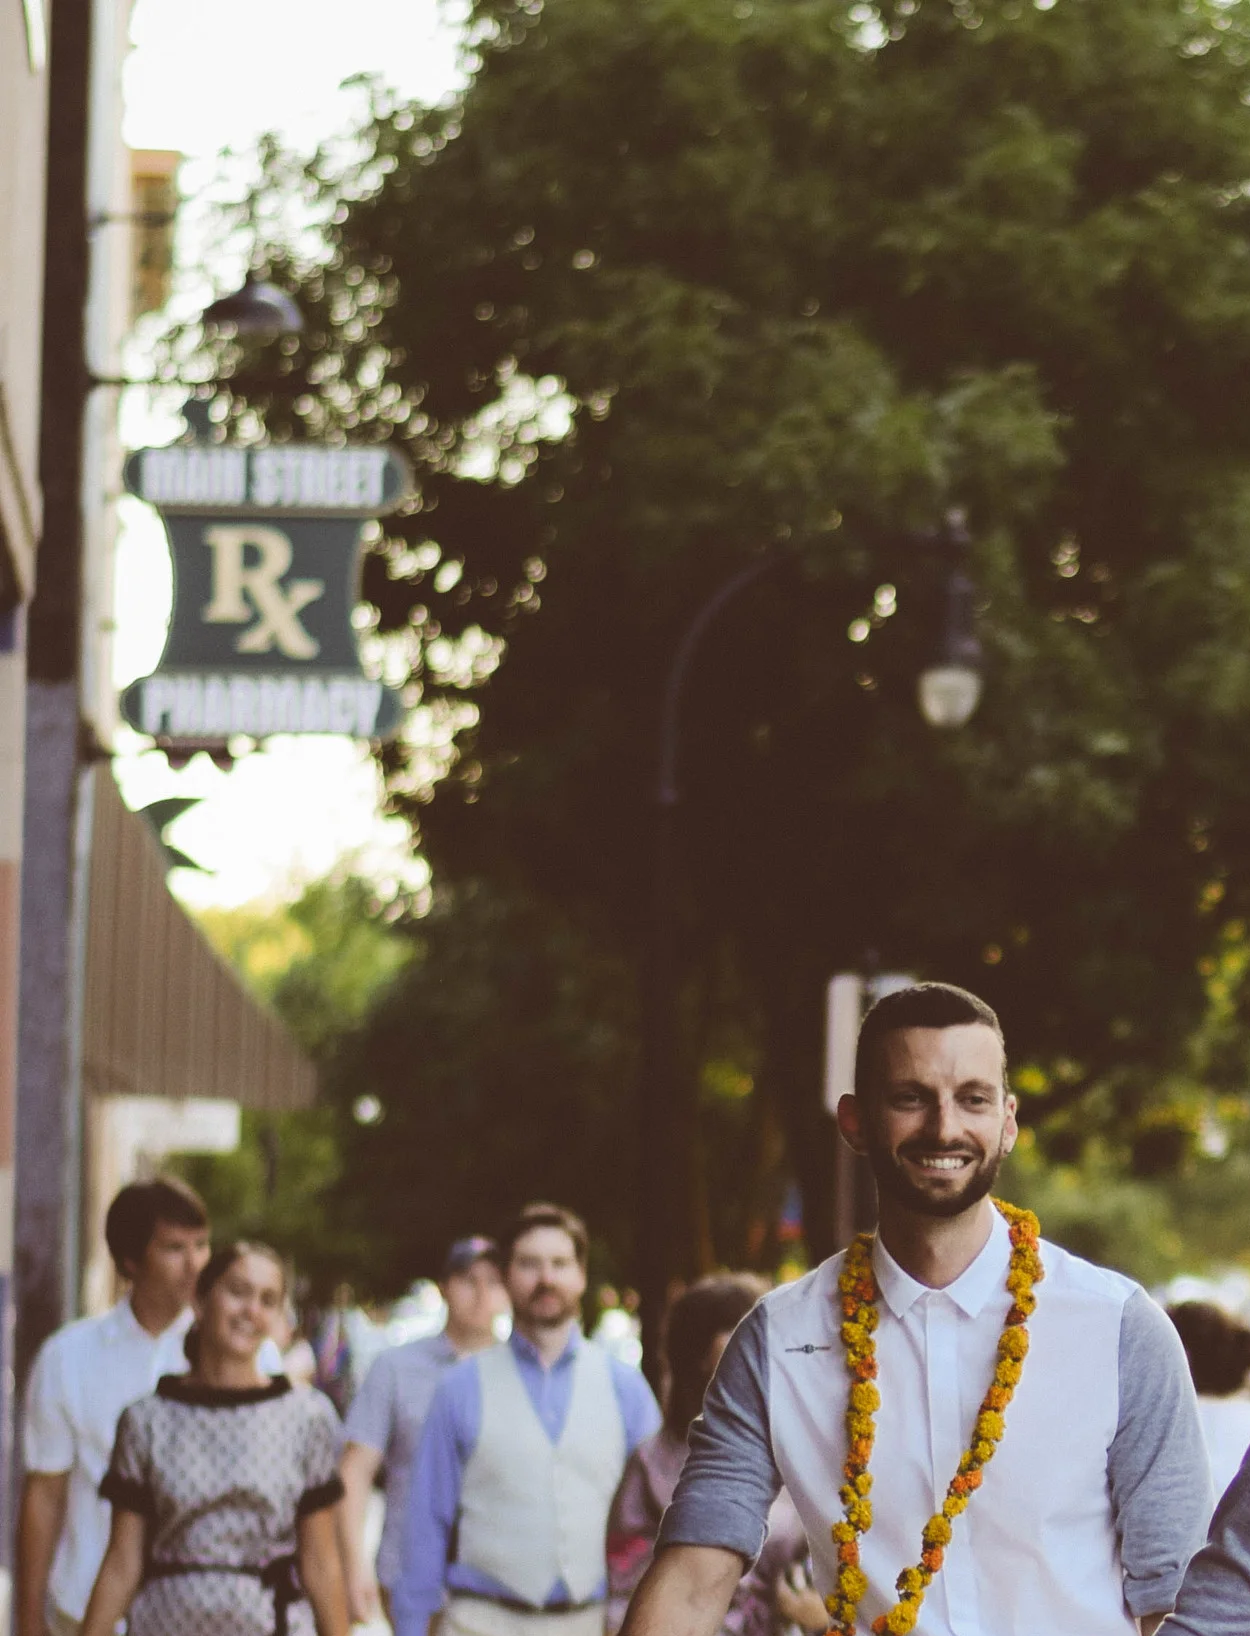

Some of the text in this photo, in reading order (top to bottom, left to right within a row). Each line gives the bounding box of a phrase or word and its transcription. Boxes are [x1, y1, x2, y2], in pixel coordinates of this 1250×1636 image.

[142, 447, 388, 509] MAIN STREET
[142, 674, 385, 736] PHARMACY
